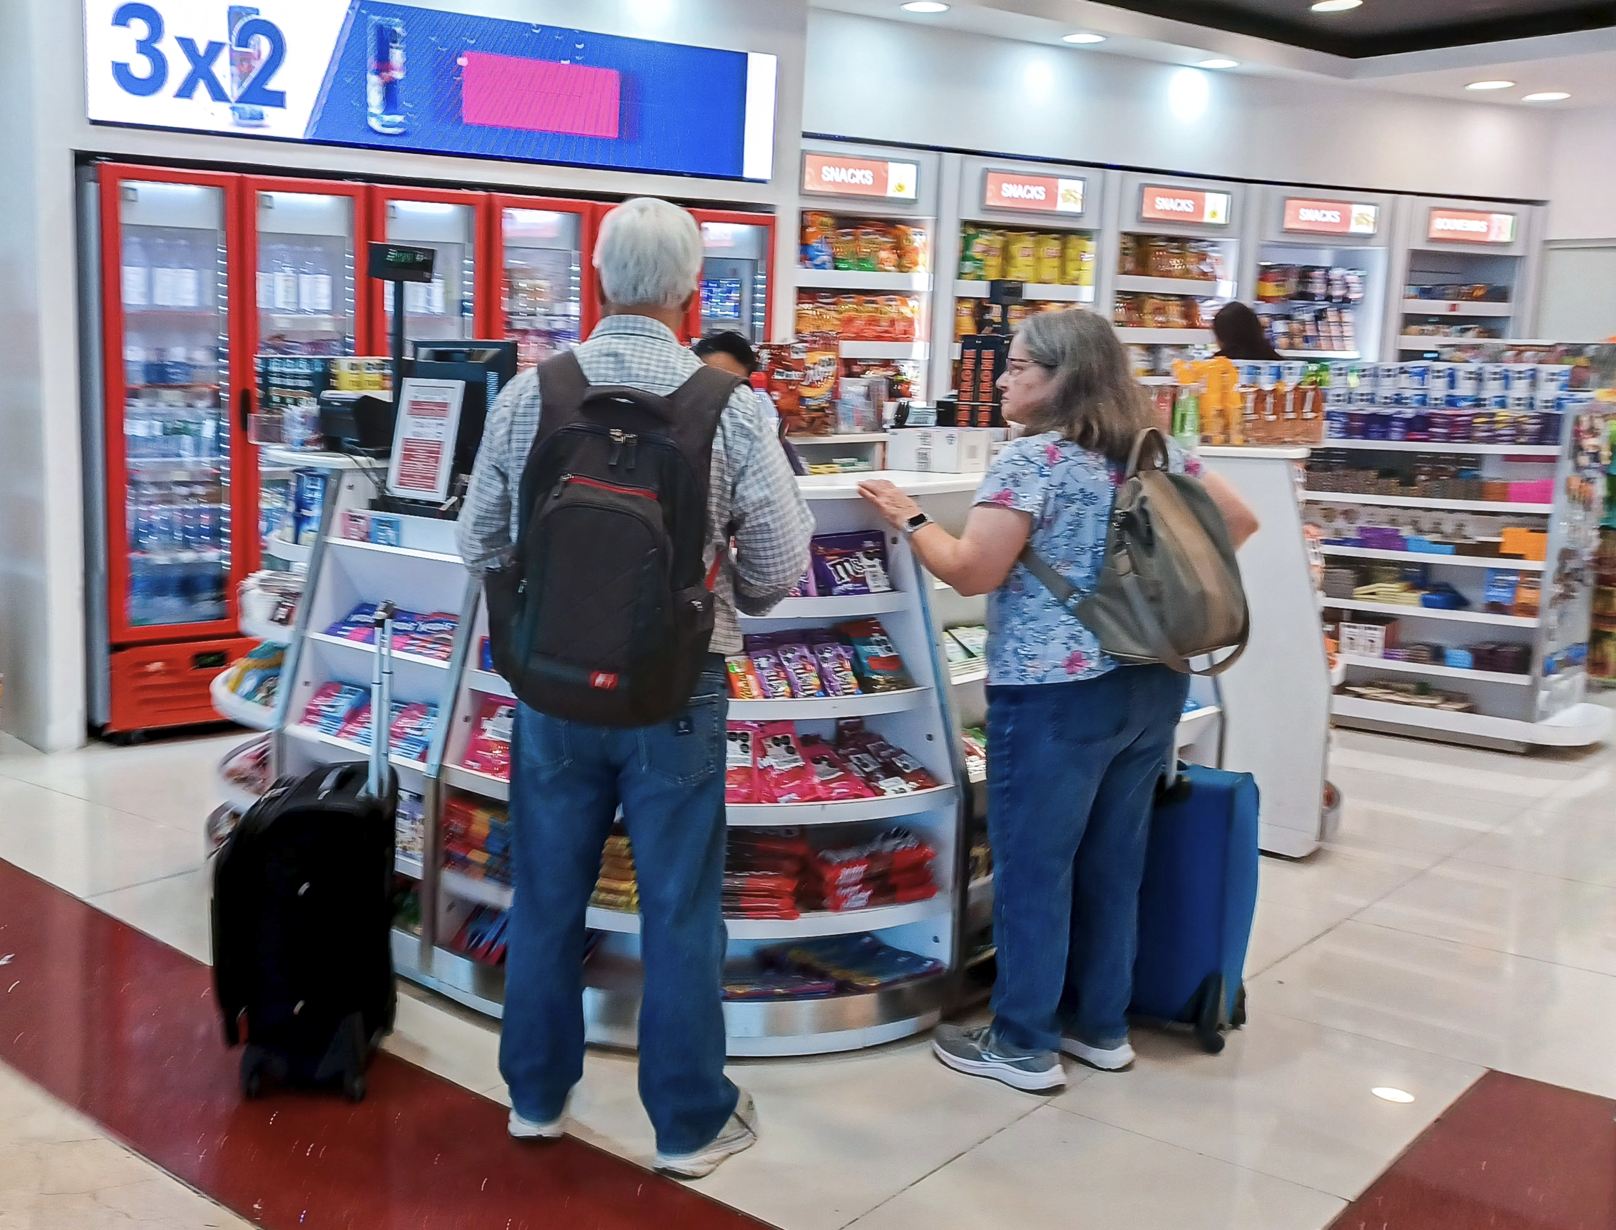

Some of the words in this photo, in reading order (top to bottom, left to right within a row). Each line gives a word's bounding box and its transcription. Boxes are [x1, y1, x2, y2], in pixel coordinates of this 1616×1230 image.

[111, 2, 287, 109] 3x2
[821, 166, 874, 186] SNACKS
[1001, 183, 1046, 201] SNACKS
[1154, 196, 1195, 213] SNACKS
[1299, 208, 1341, 223] SNACKS
